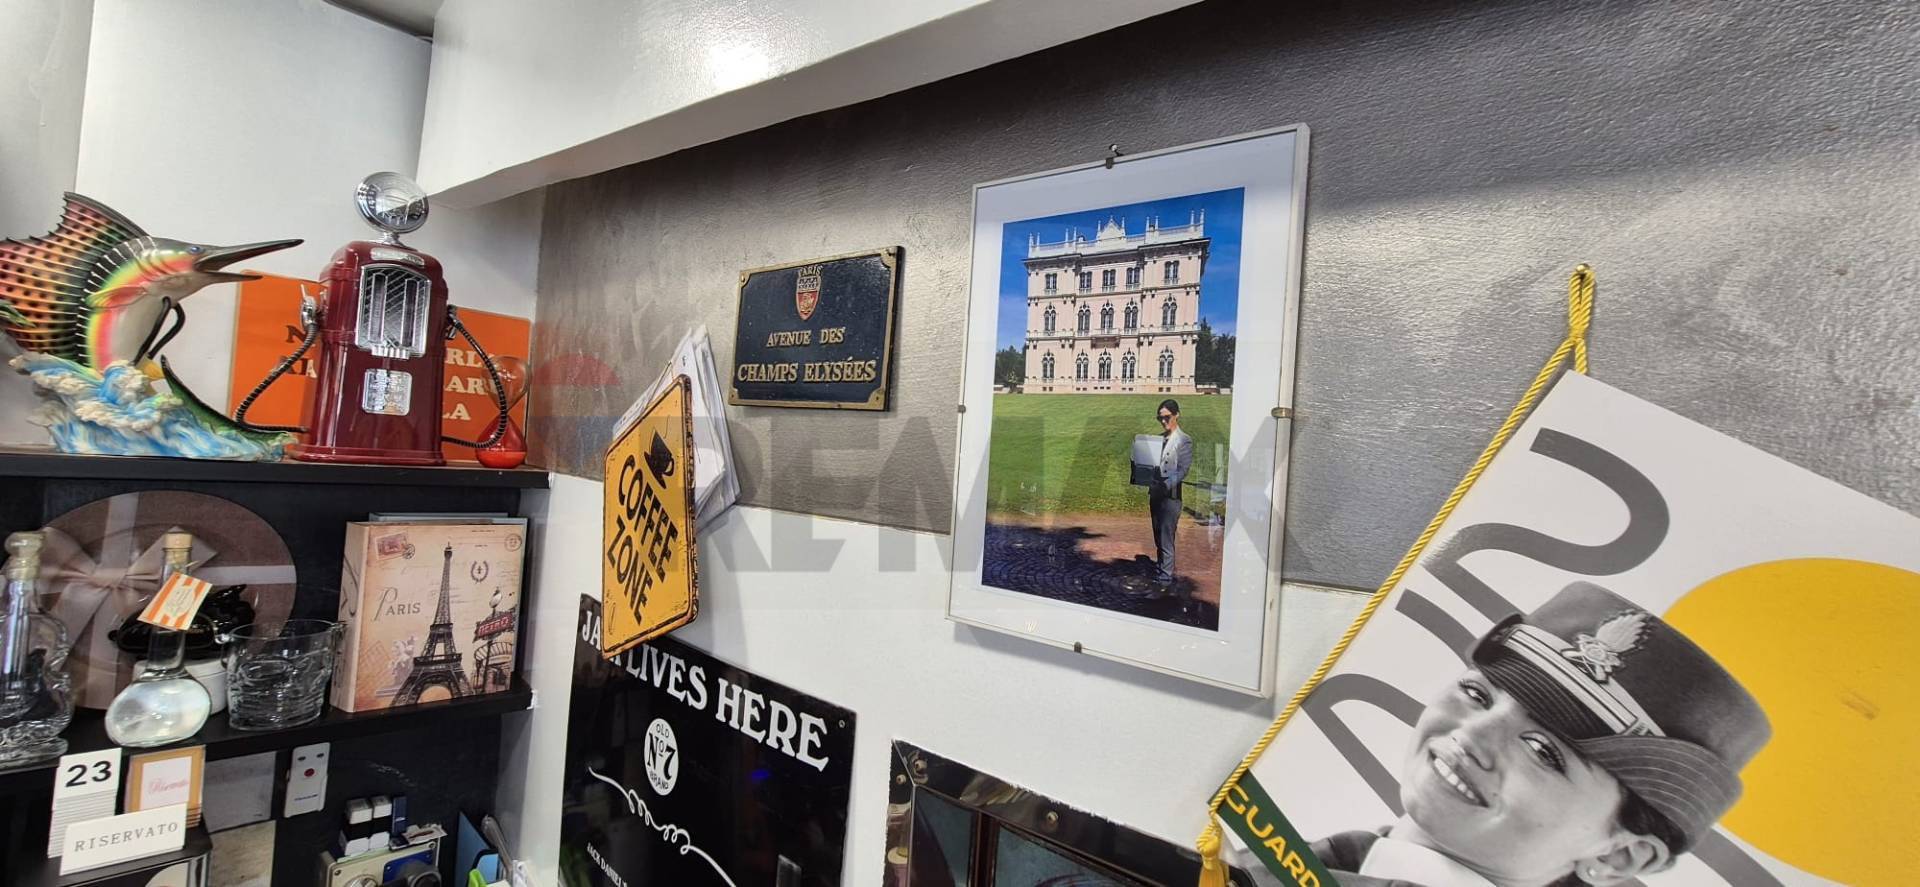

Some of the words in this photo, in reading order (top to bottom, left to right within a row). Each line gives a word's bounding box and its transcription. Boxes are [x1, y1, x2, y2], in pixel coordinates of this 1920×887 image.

[766, 329, 812, 348] AVENUE
[820, 327, 846, 344] DES
[737, 362, 799, 383] CHAMPS
[803, 356, 877, 383] ELYSÉES
[618, 454, 679, 584] COFFEE
[607, 514, 653, 626] ZONE
[626, 643, 708, 710] LIVES
[715, 677, 829, 772] HERE
[656, 723, 669, 738] OLD
[65, 760, 112, 788] 23
[74, 821, 178, 852] RISERVATO
